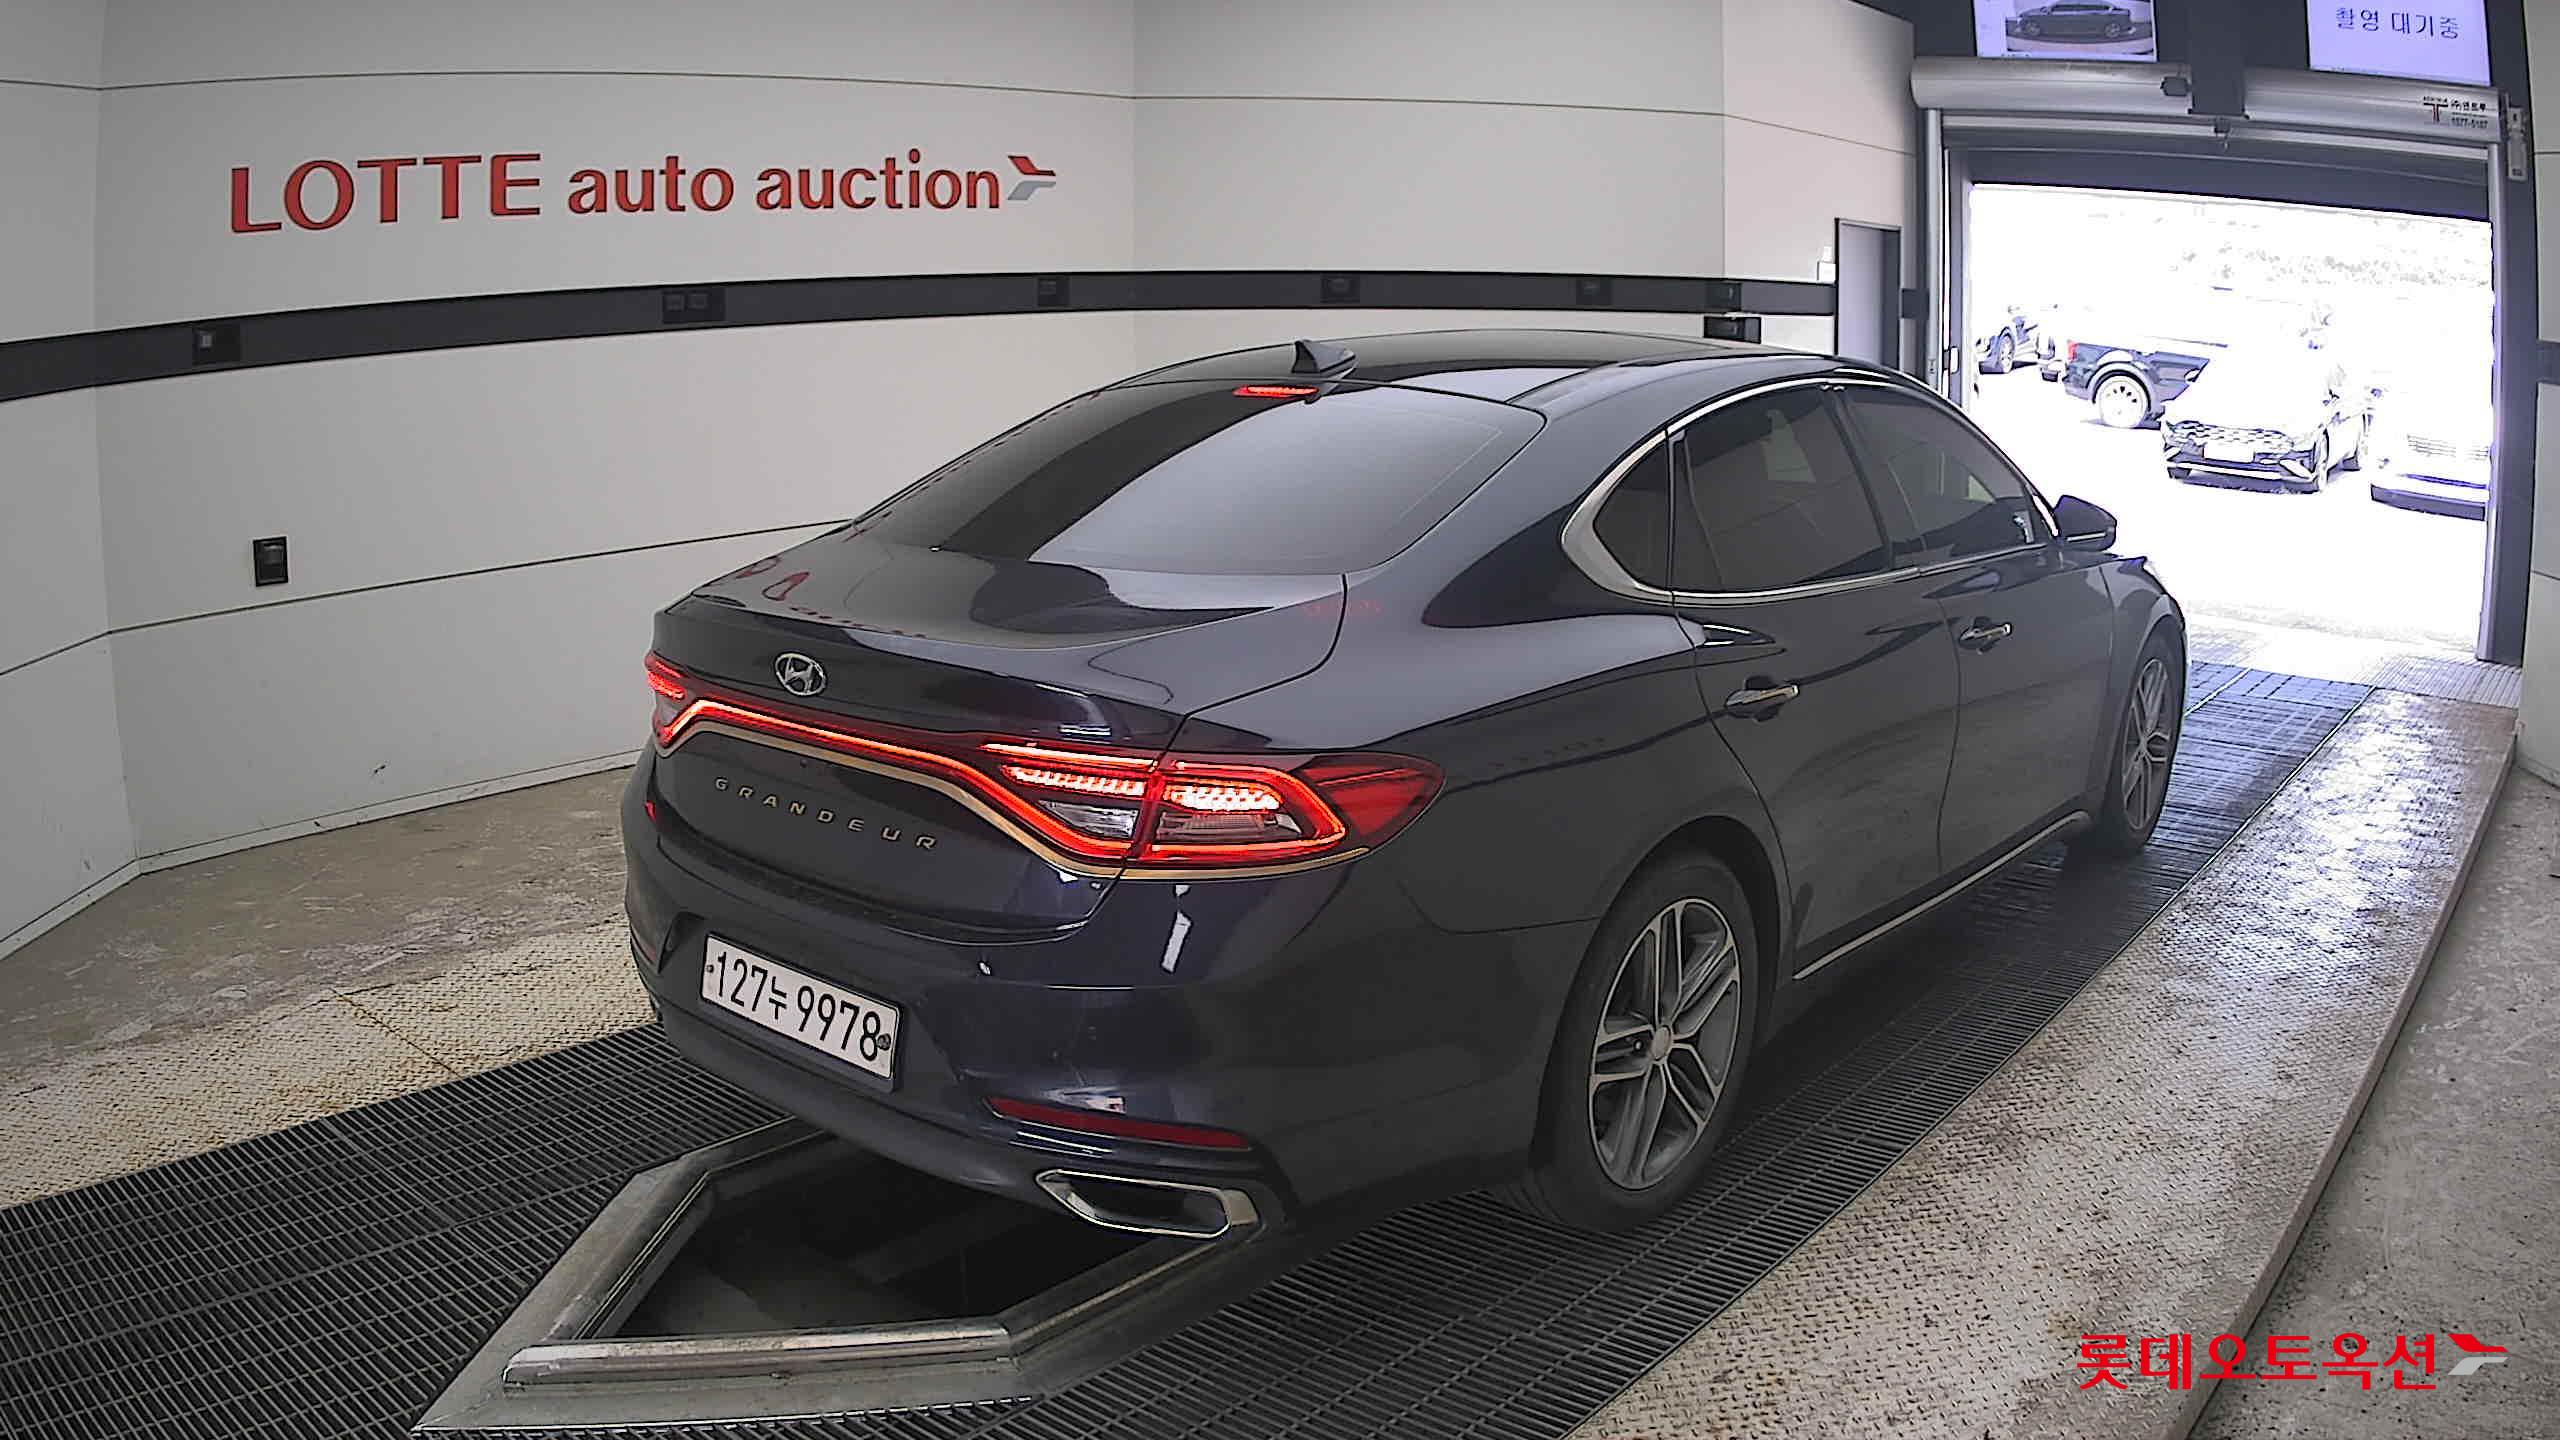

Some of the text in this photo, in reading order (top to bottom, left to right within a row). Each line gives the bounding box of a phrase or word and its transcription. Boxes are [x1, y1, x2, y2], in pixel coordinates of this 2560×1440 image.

[2336, 7, 2459, 39] 촬영 대기중
[231, 148, 1001, 233] LOTTE auto auction
[714, 776, 937, 850] GRANDEUR
[717, 951, 881, 1062] 127누9978
